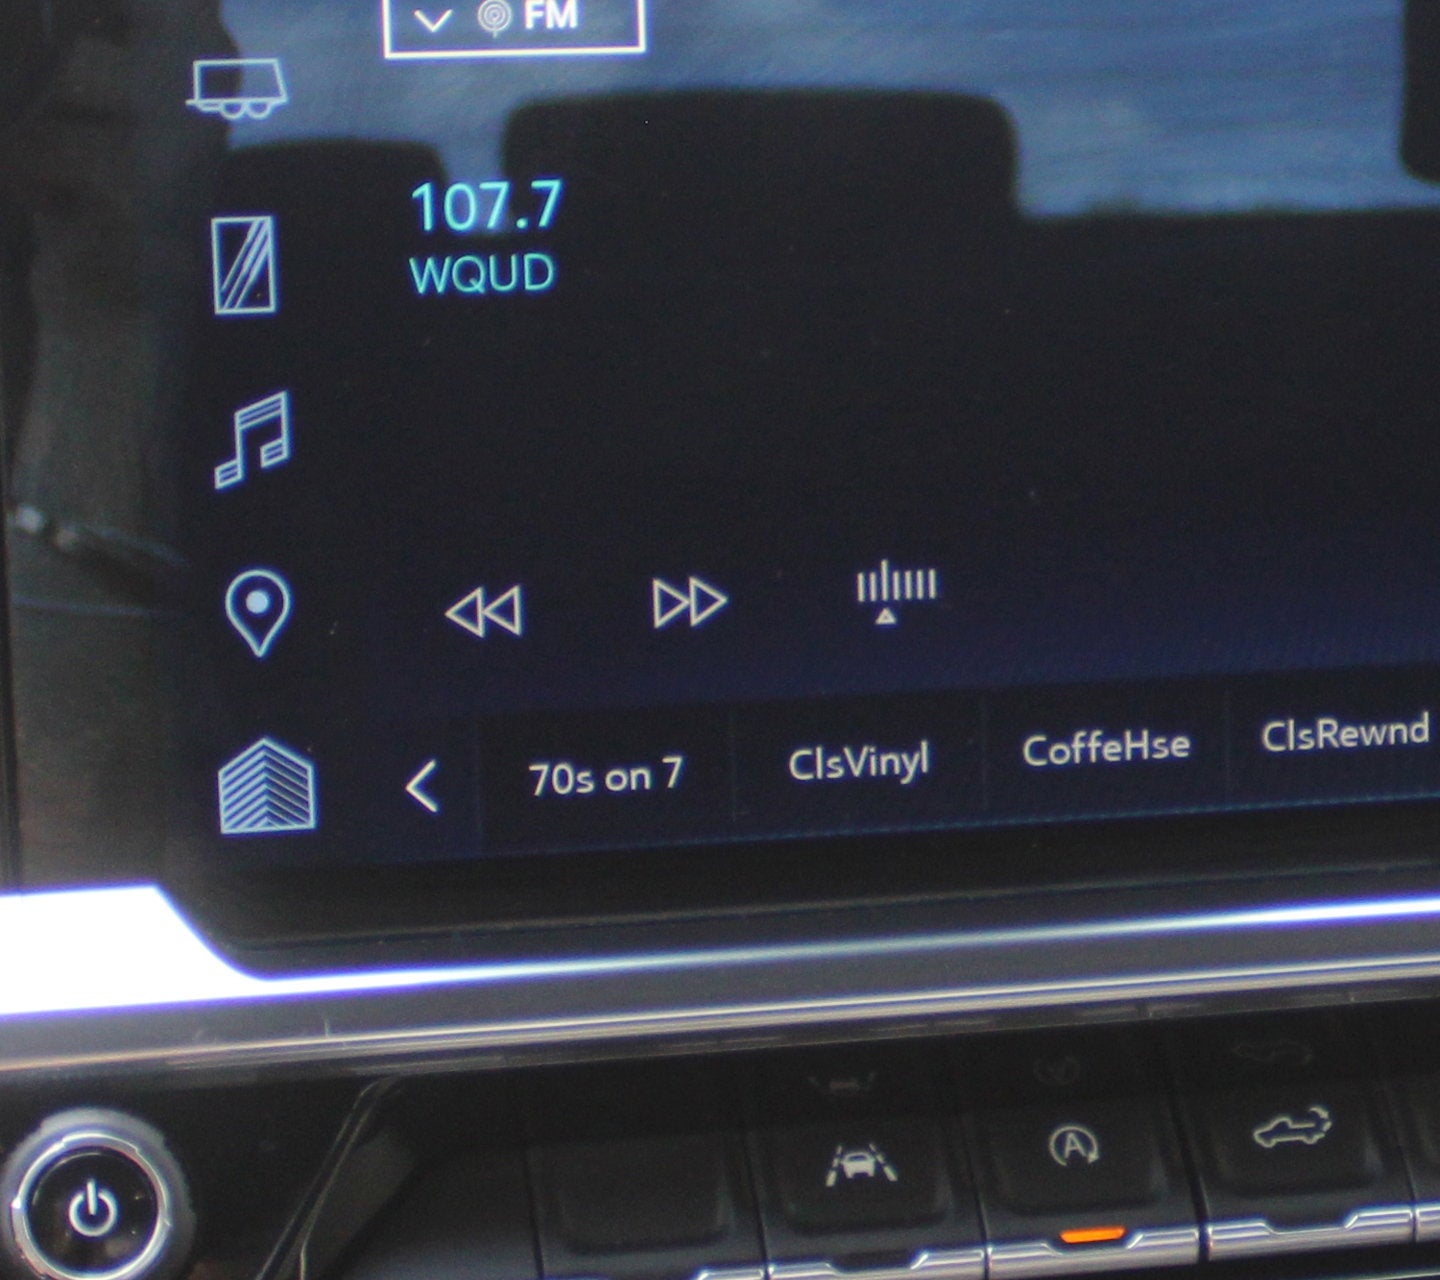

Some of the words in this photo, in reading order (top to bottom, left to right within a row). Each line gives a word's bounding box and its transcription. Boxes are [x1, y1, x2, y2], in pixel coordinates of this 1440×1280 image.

[411, 179, 562, 232] 107.7
[408, 252, 555, 295] WQUD
[1022, 729, 1191, 767] CoffeHse
[1261, 710, 1430, 753] ClsRewnd
[528, 762, 595, 796] 70s
[604, 767, 652, 792] on
[662, 755, 684, 788] 7
[788, 739, 930, 785] ClsVinyl
